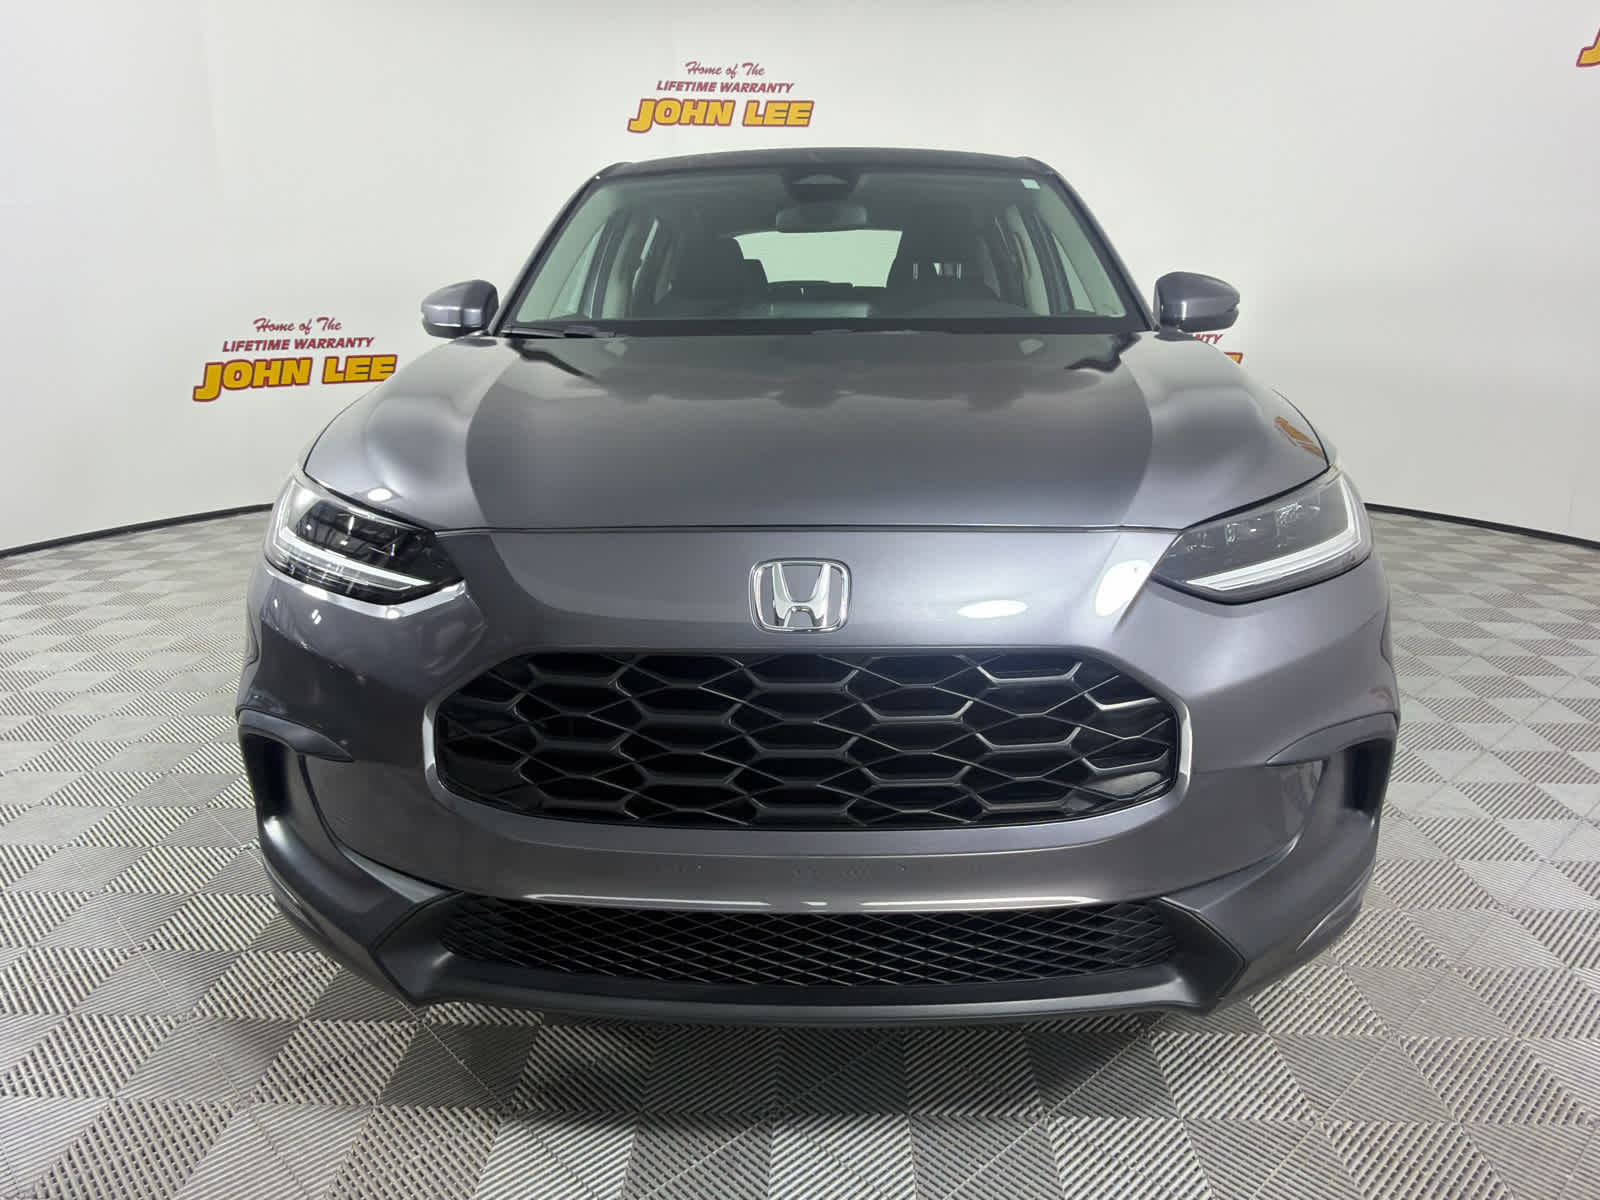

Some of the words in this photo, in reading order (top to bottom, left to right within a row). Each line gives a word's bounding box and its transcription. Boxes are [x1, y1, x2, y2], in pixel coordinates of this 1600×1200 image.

[685, 61, 722, 76] Home
[725, 63, 738, 79] of
[742, 62, 766, 76] The
[656, 80, 718, 92] LIFETIME
[720, 81, 794, 94] WARRANTY
[627, 98, 736, 133] JOHN
[742, 99, 815, 127] LEE
[253, 317, 295, 333] Home
[298, 318, 313, 335] of
[316, 316, 342, 331] The
[222, 338, 290, 353] LIFETIME
[294, 336, 375, 351] WARRANTY
[192, 356, 313, 402] JOHN
[321, 354, 397, 384] LEE
